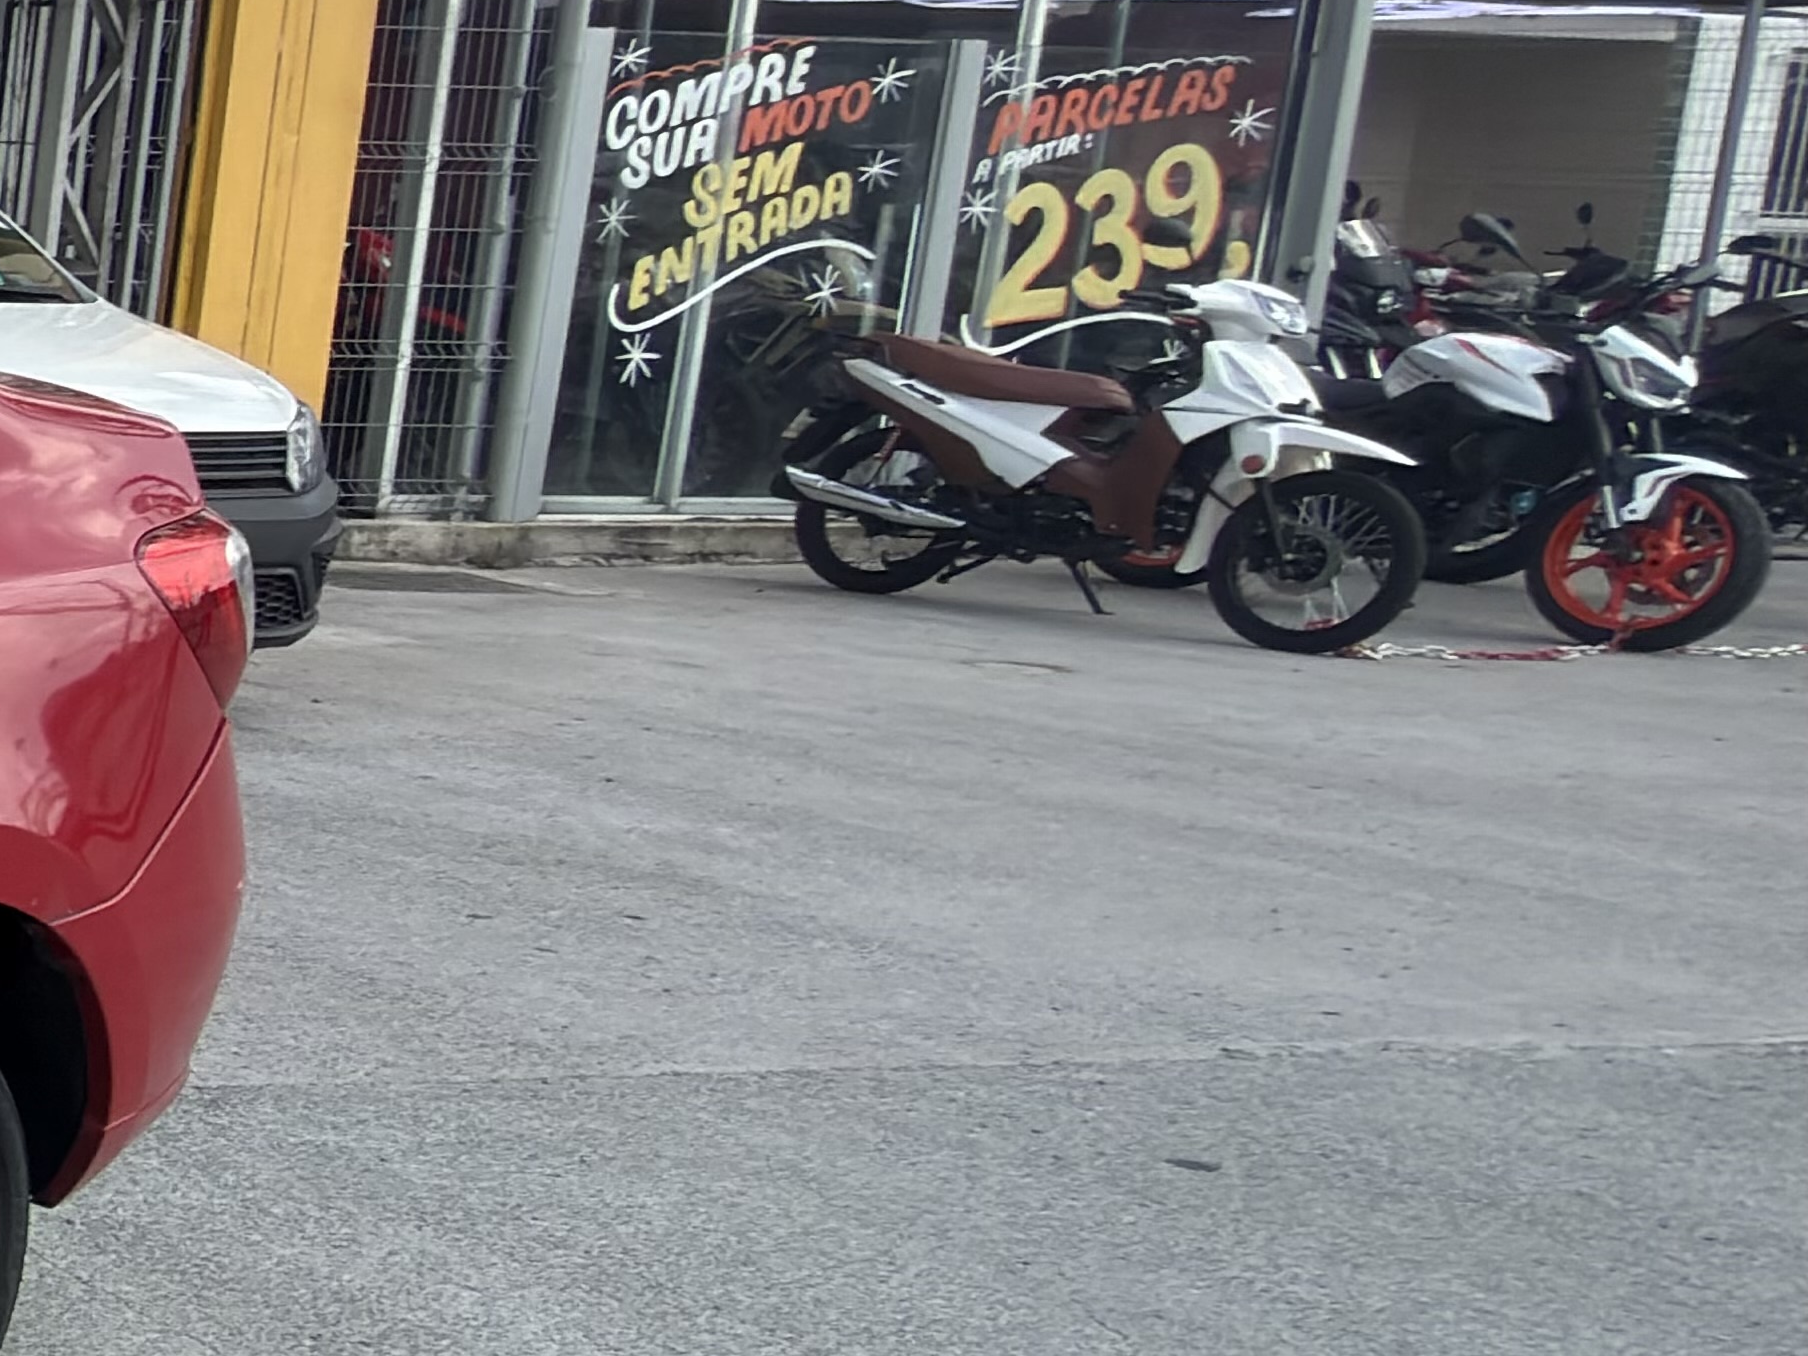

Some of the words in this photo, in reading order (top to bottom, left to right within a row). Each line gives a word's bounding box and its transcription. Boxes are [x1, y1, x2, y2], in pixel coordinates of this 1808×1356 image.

[606, 45, 817, 150] COMPRE
[620, 118, 718, 189] SUA
[738, 80, 873, 153] MOTO
[988, 65, 1235, 155] PARCELAS
[683, 142, 805, 229] SEM
[628, 171, 854, 311] ENTRADA
